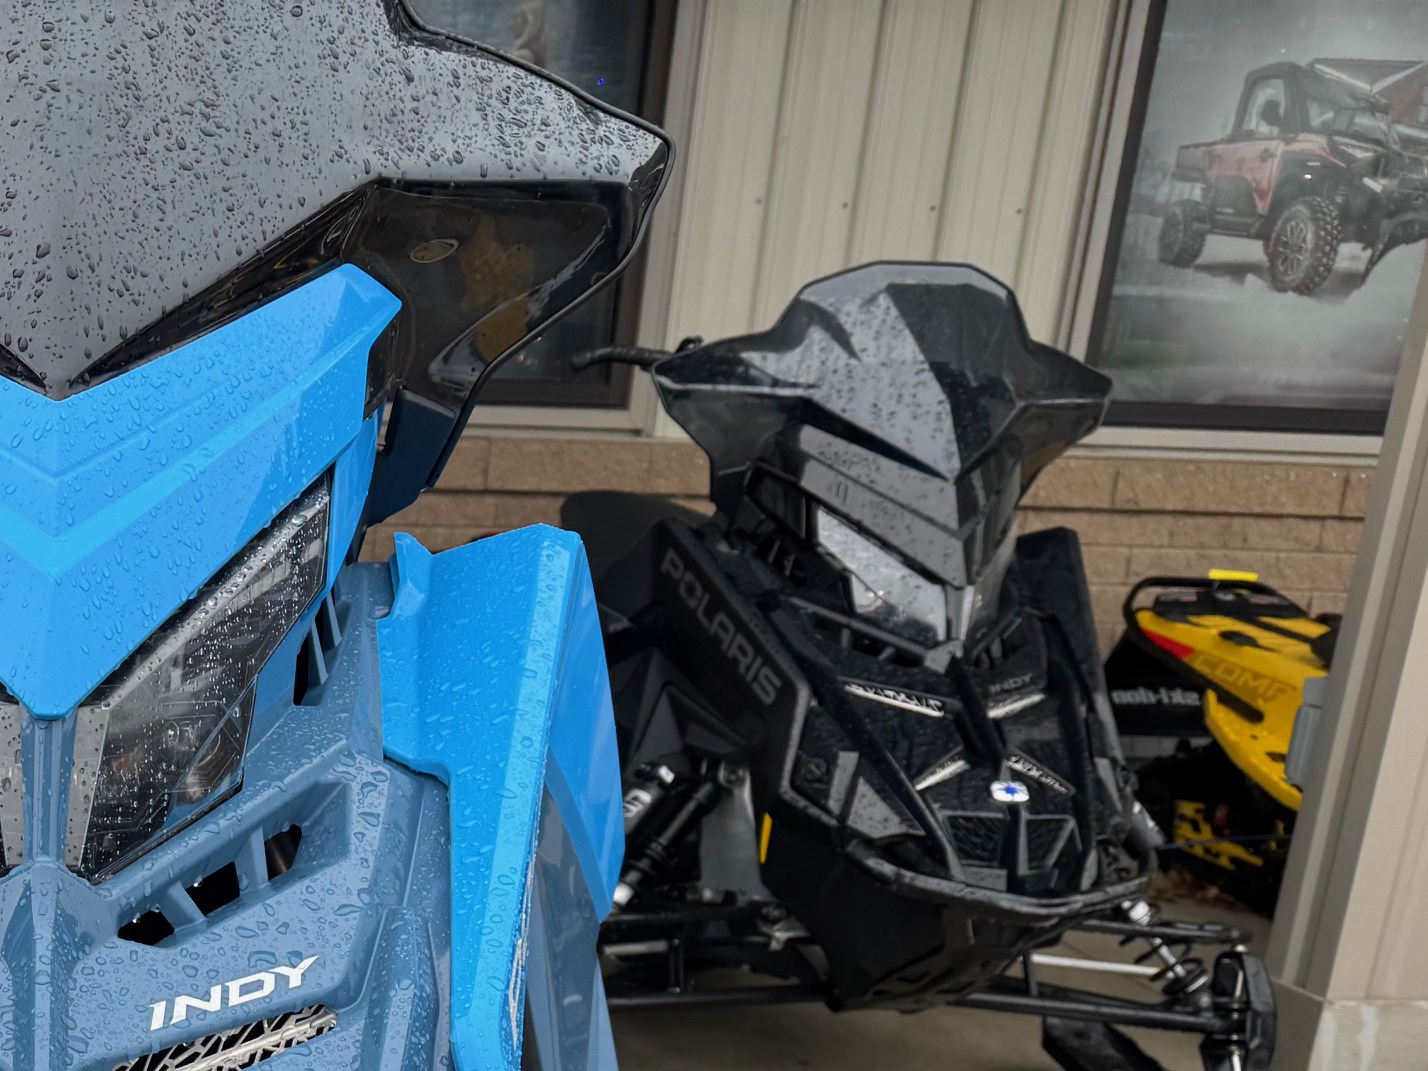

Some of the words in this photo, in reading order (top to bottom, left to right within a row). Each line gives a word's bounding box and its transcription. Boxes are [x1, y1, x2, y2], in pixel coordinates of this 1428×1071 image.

[660, 547, 783, 705] POLARIS
[989, 672, 1033, 694] INDY
[149, 955, 319, 1031] INDY
